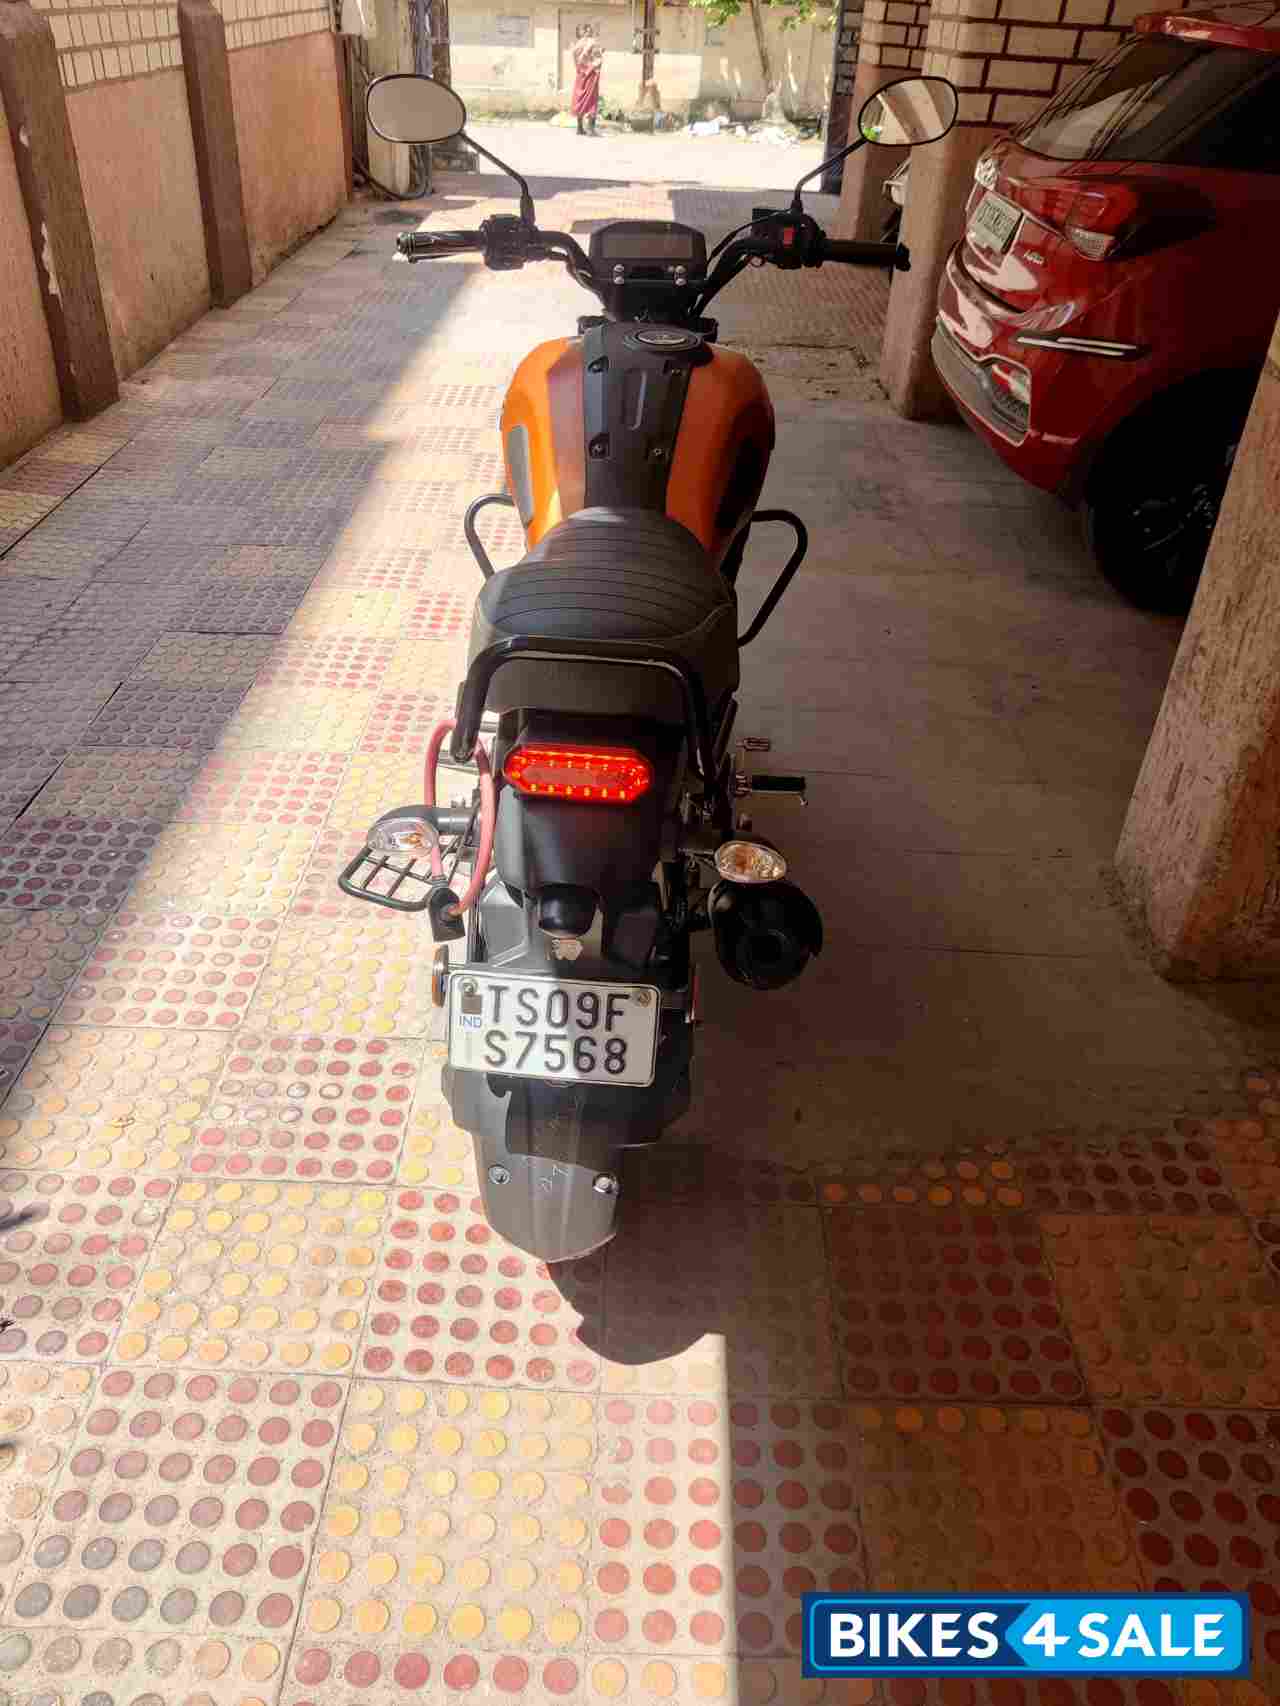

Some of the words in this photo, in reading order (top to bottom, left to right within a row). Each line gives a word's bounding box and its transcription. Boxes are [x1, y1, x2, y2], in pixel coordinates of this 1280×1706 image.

[459, 1015, 482, 1028] IND
[487, 985, 630, 1032] TS09F
[483, 1029, 628, 1075] S7568
